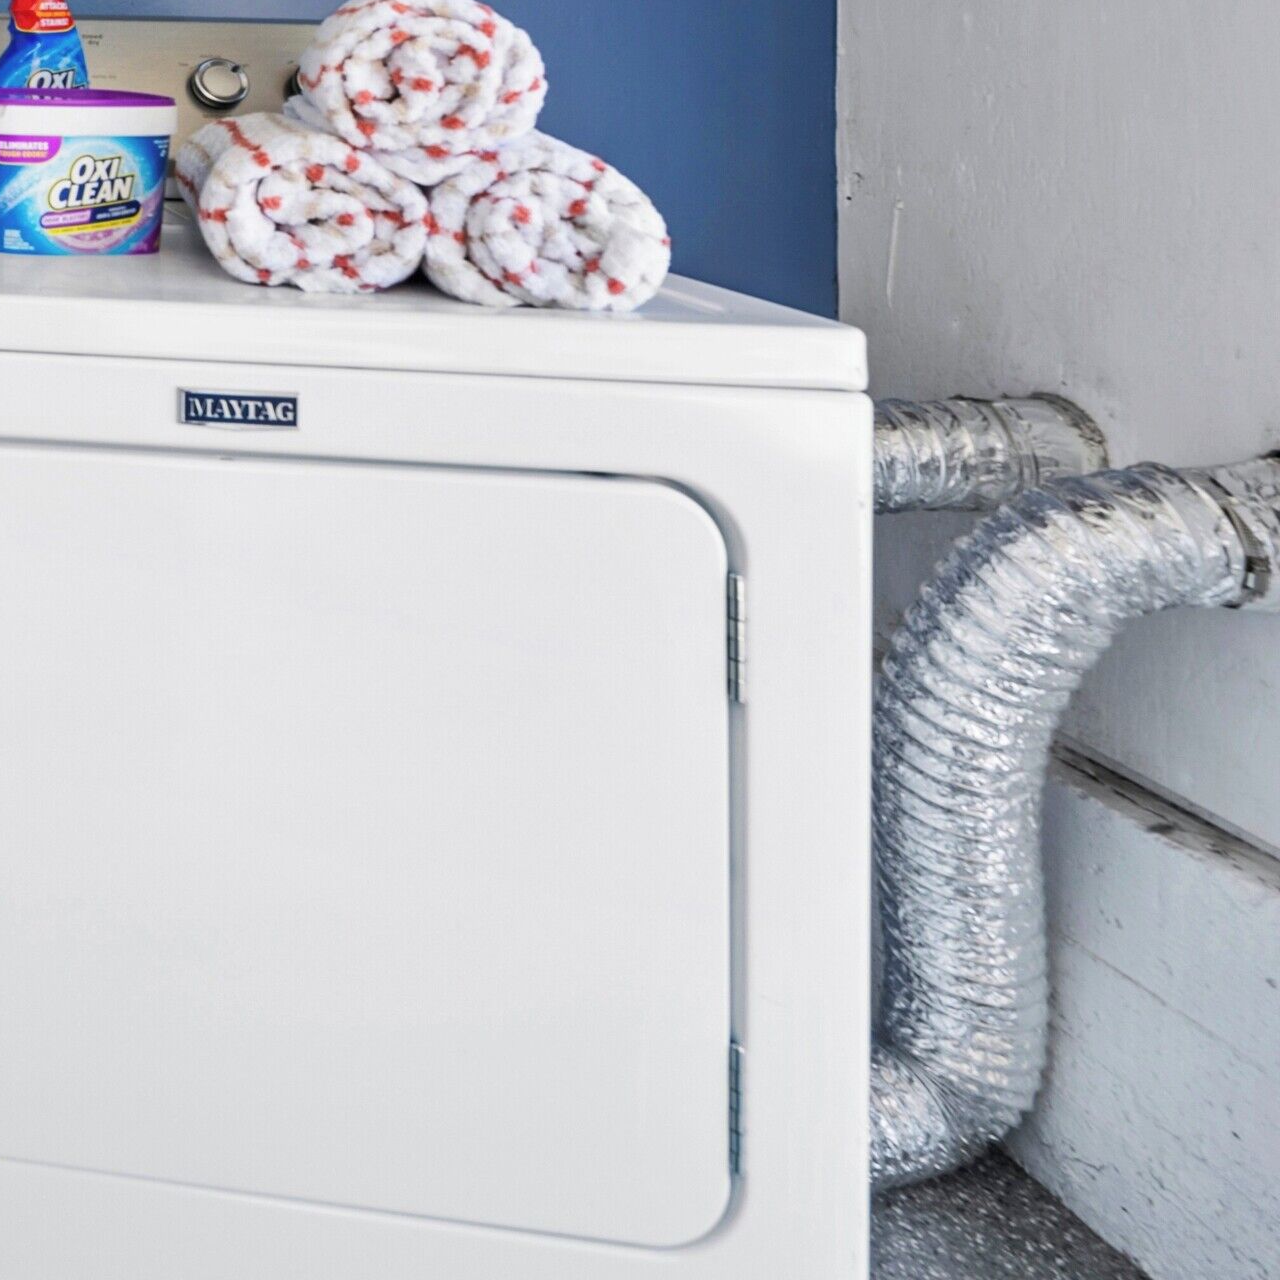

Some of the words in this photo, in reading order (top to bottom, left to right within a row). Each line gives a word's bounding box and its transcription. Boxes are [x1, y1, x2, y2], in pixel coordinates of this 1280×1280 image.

[28, 70, 75, 88] OXI
[71, 156, 120, 185] OXI
[49, 176, 133, 209] CLEAN
[189, 397, 294, 422] MAYTAG
